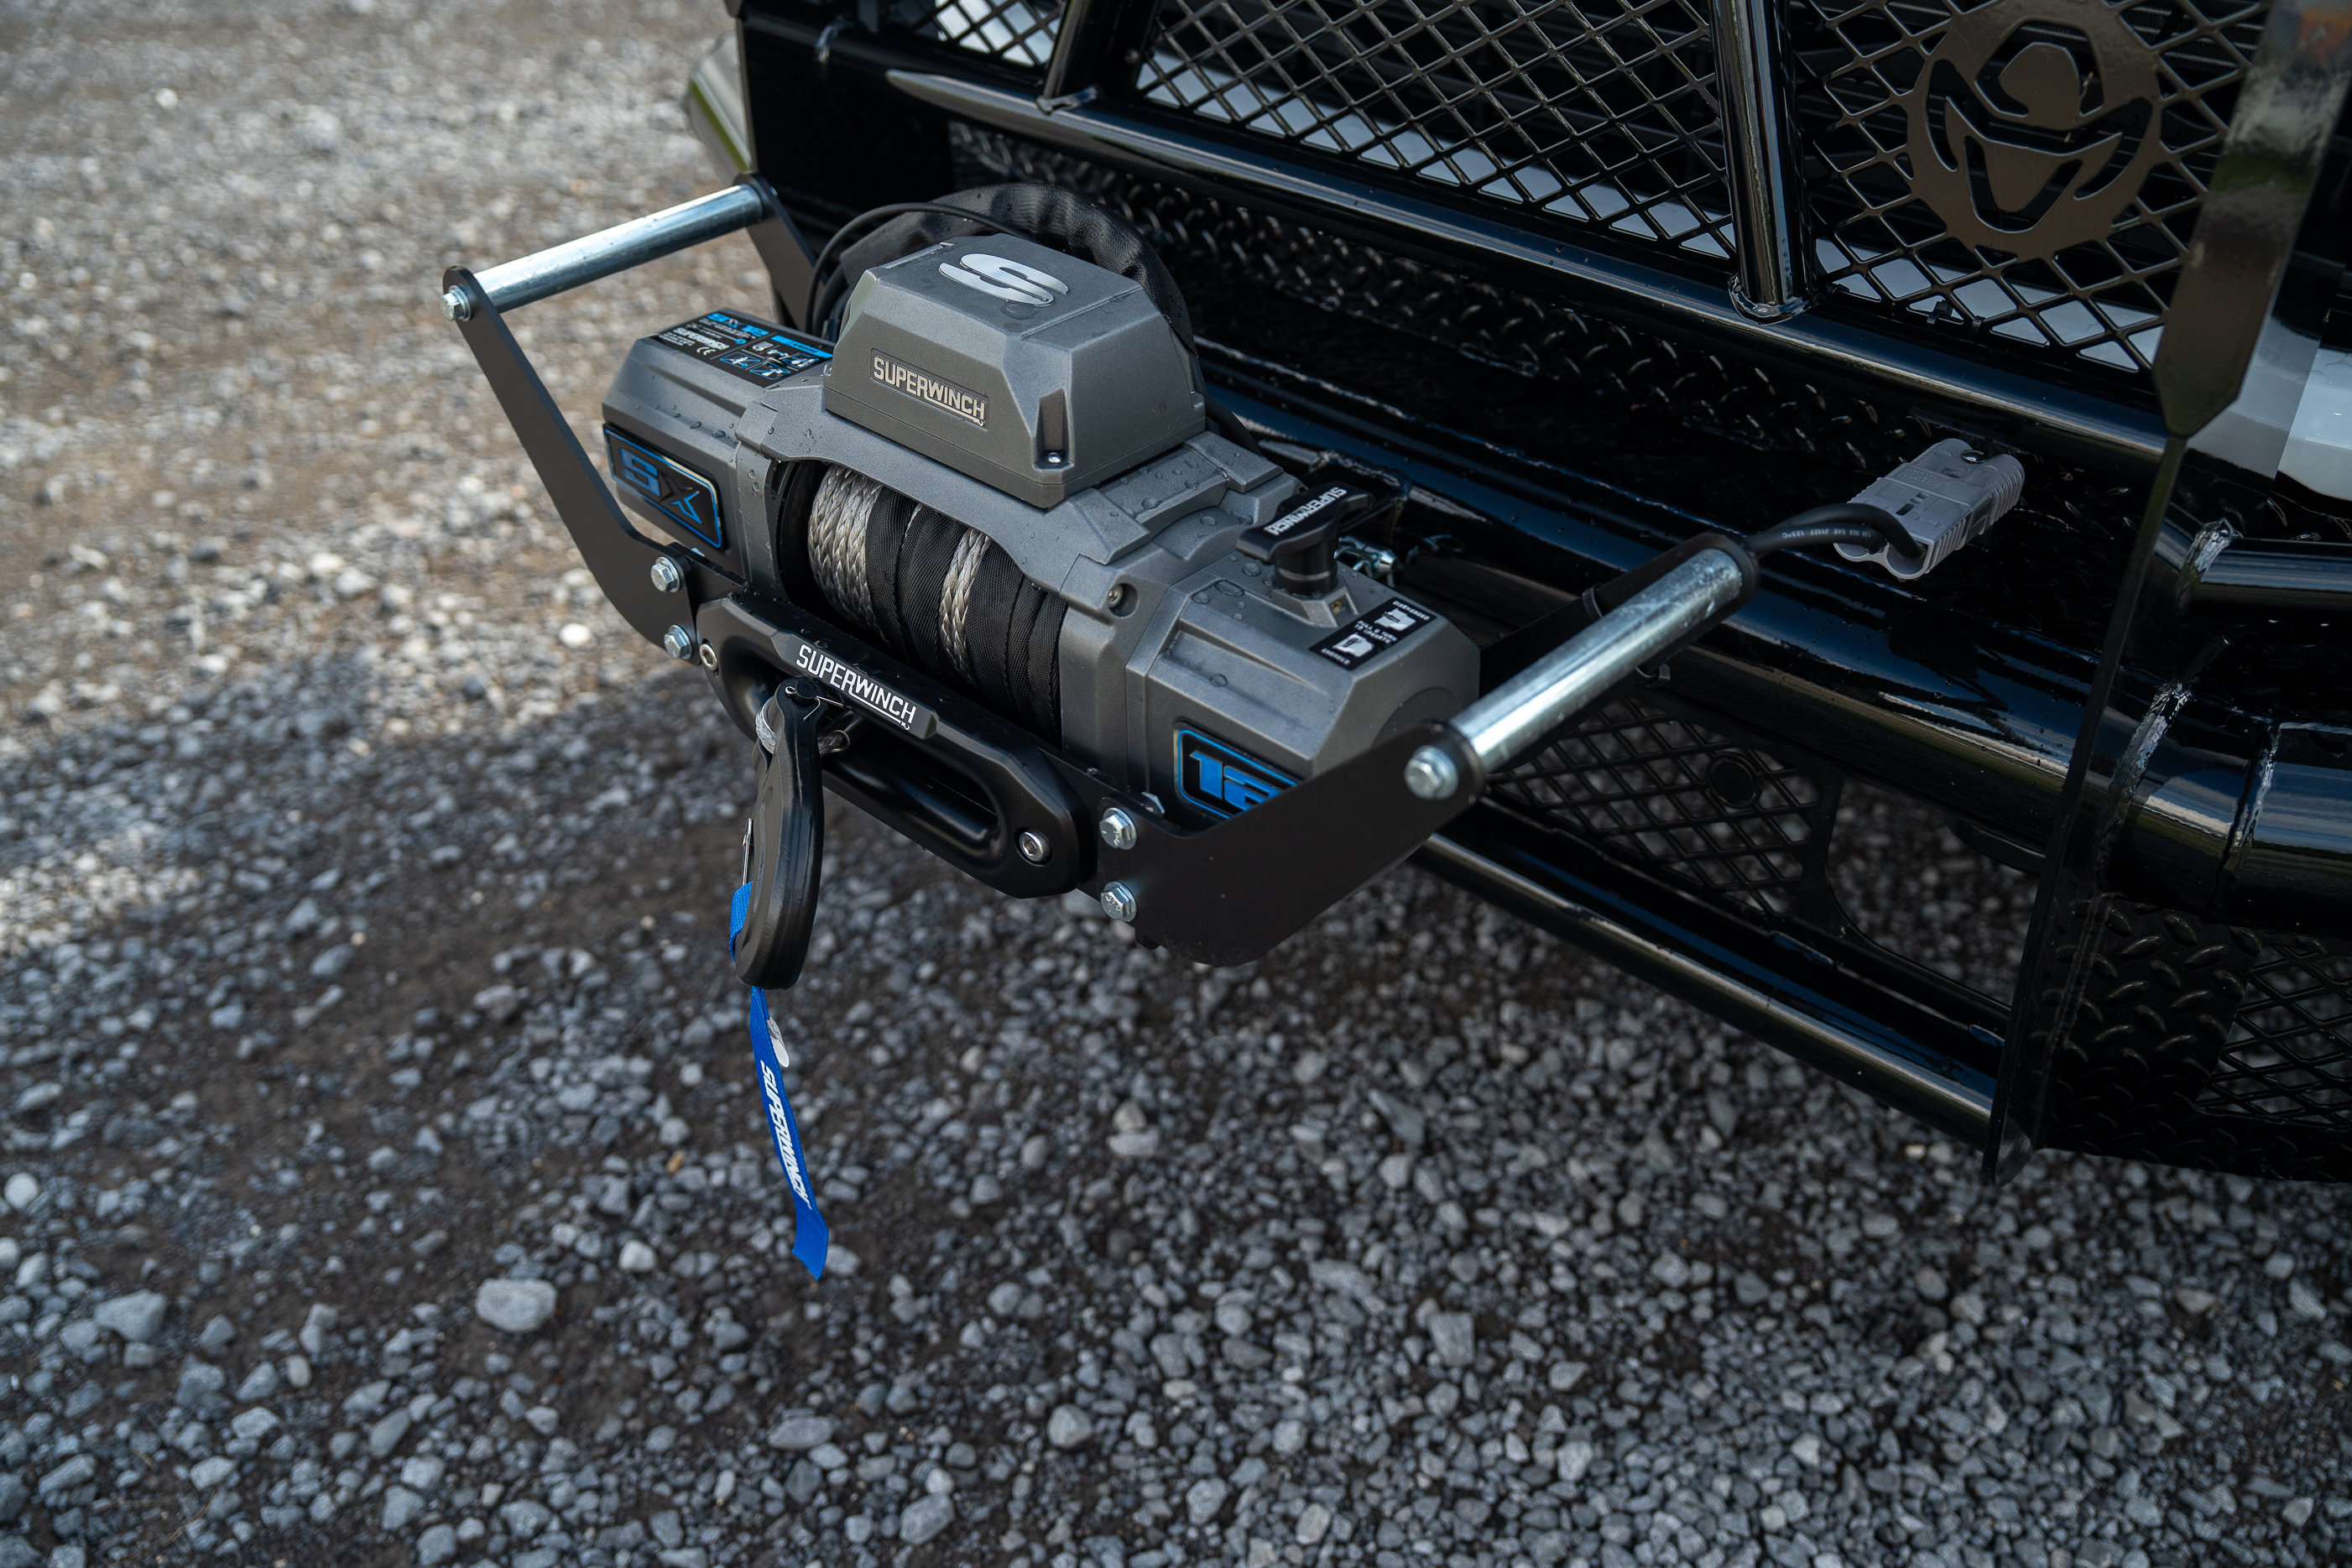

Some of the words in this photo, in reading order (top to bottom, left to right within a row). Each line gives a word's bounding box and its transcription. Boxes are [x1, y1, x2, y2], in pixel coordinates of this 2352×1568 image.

[873, 355, 987, 427] SUPERWINCH
[619, 447, 702, 524] SX
[1263, 487, 1348, 536] SUPERWINCH
[795, 643, 918, 731] SUPERWINCH
[759, 1059, 810, 1205] SUPERWINCH
